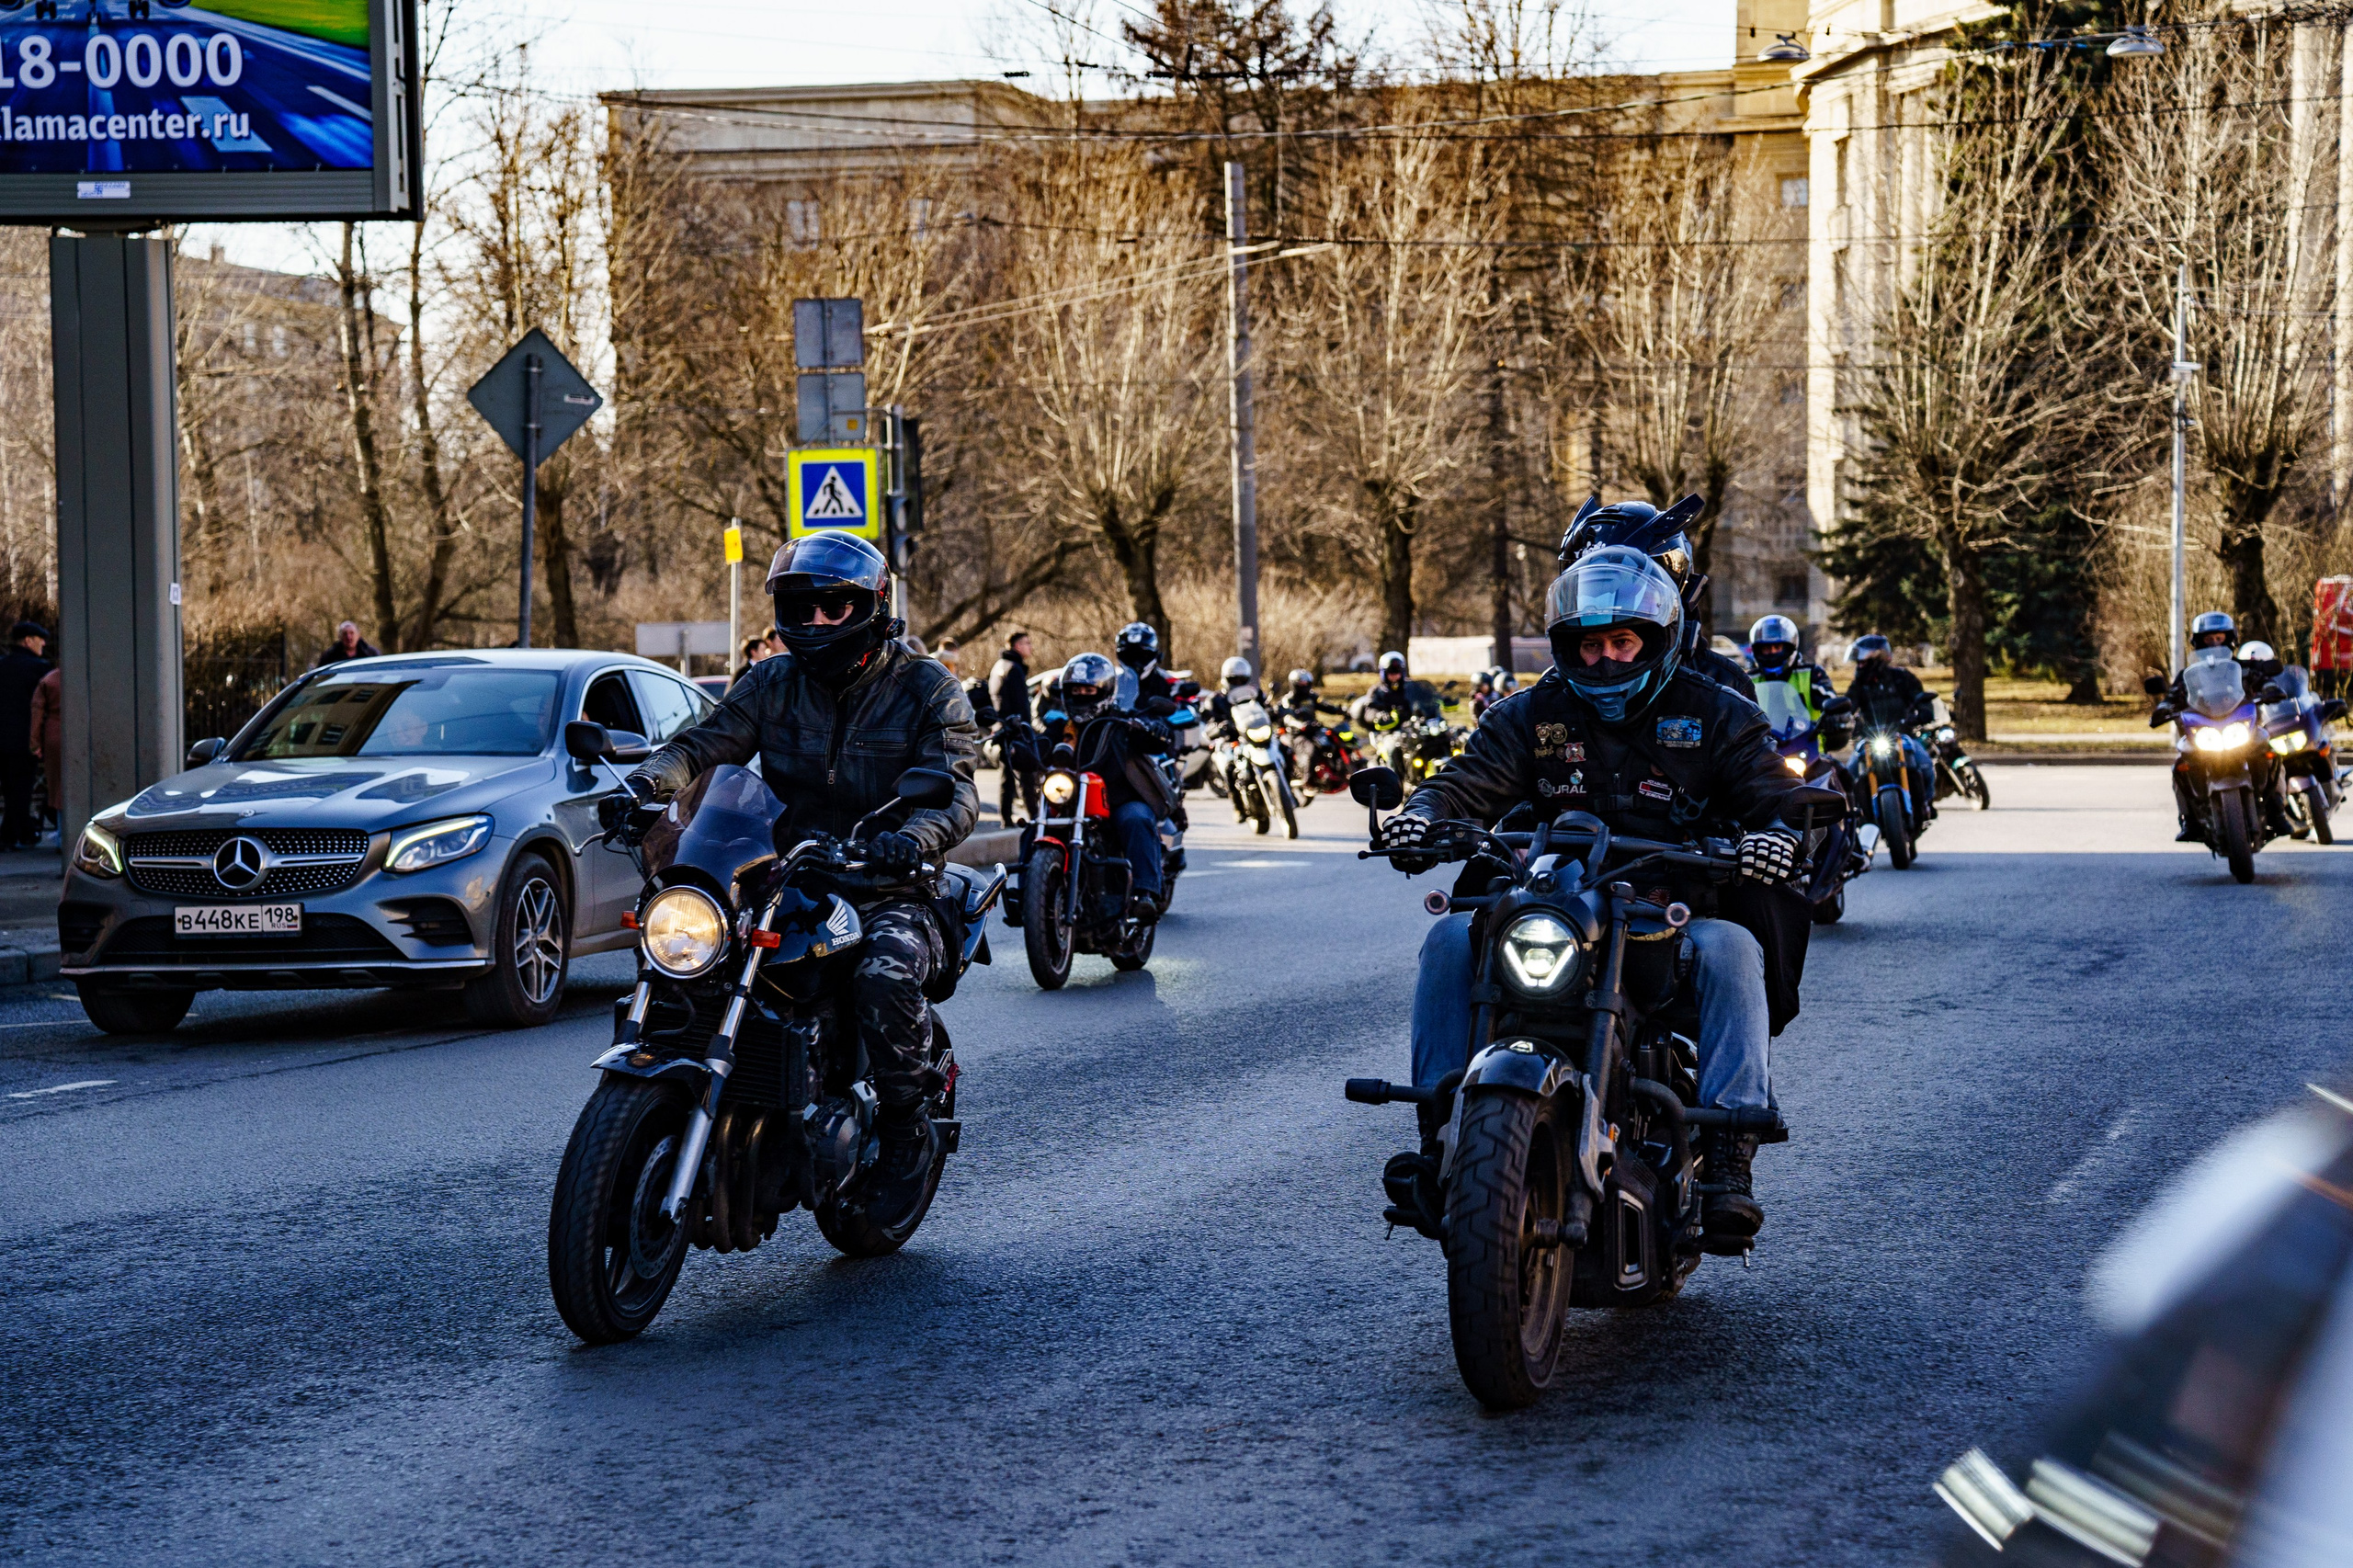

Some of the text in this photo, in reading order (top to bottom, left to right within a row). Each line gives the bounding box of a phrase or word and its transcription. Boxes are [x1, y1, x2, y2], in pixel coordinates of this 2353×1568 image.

[0, 106, 250, 141] lamacenter.ru
[1552, 784, 1586, 795] URAL
[264, 907, 294, 923] 198
[831, 931, 860, 947] HONDA
